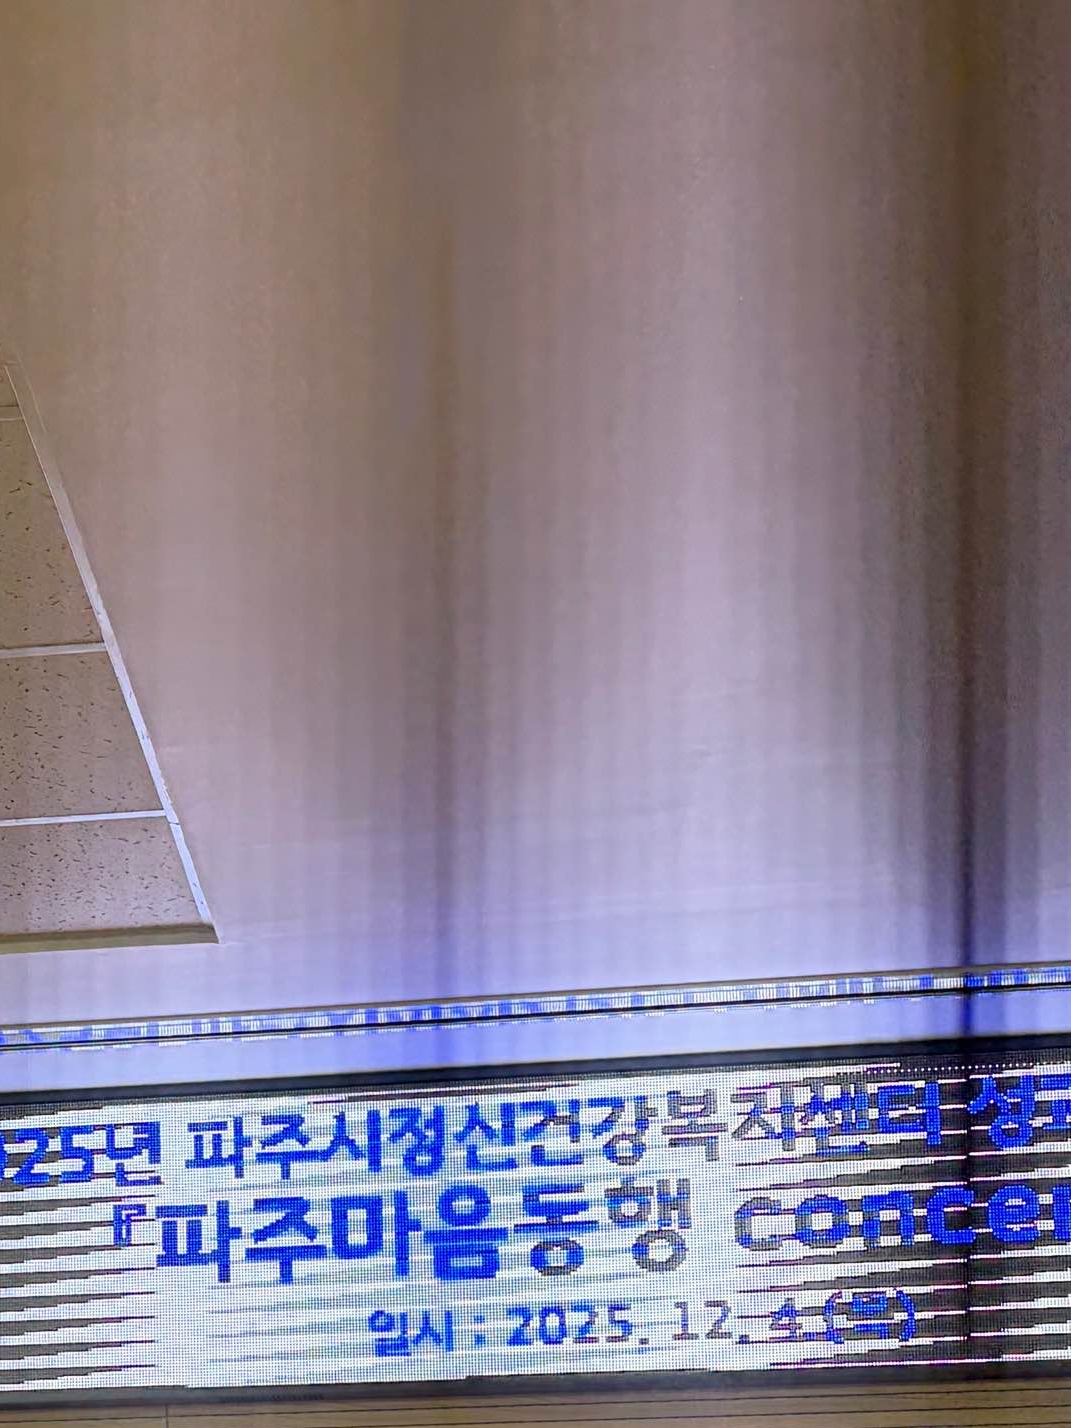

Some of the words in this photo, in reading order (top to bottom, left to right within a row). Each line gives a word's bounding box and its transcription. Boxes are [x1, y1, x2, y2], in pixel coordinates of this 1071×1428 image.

[185, 1077, 941, 1180] 파주시정신건강복지센터
[369, 1309, 453, 1357] 일시
[507, 1304, 651, 1346] 2025.
[674, 1300, 748, 1345] 12.
